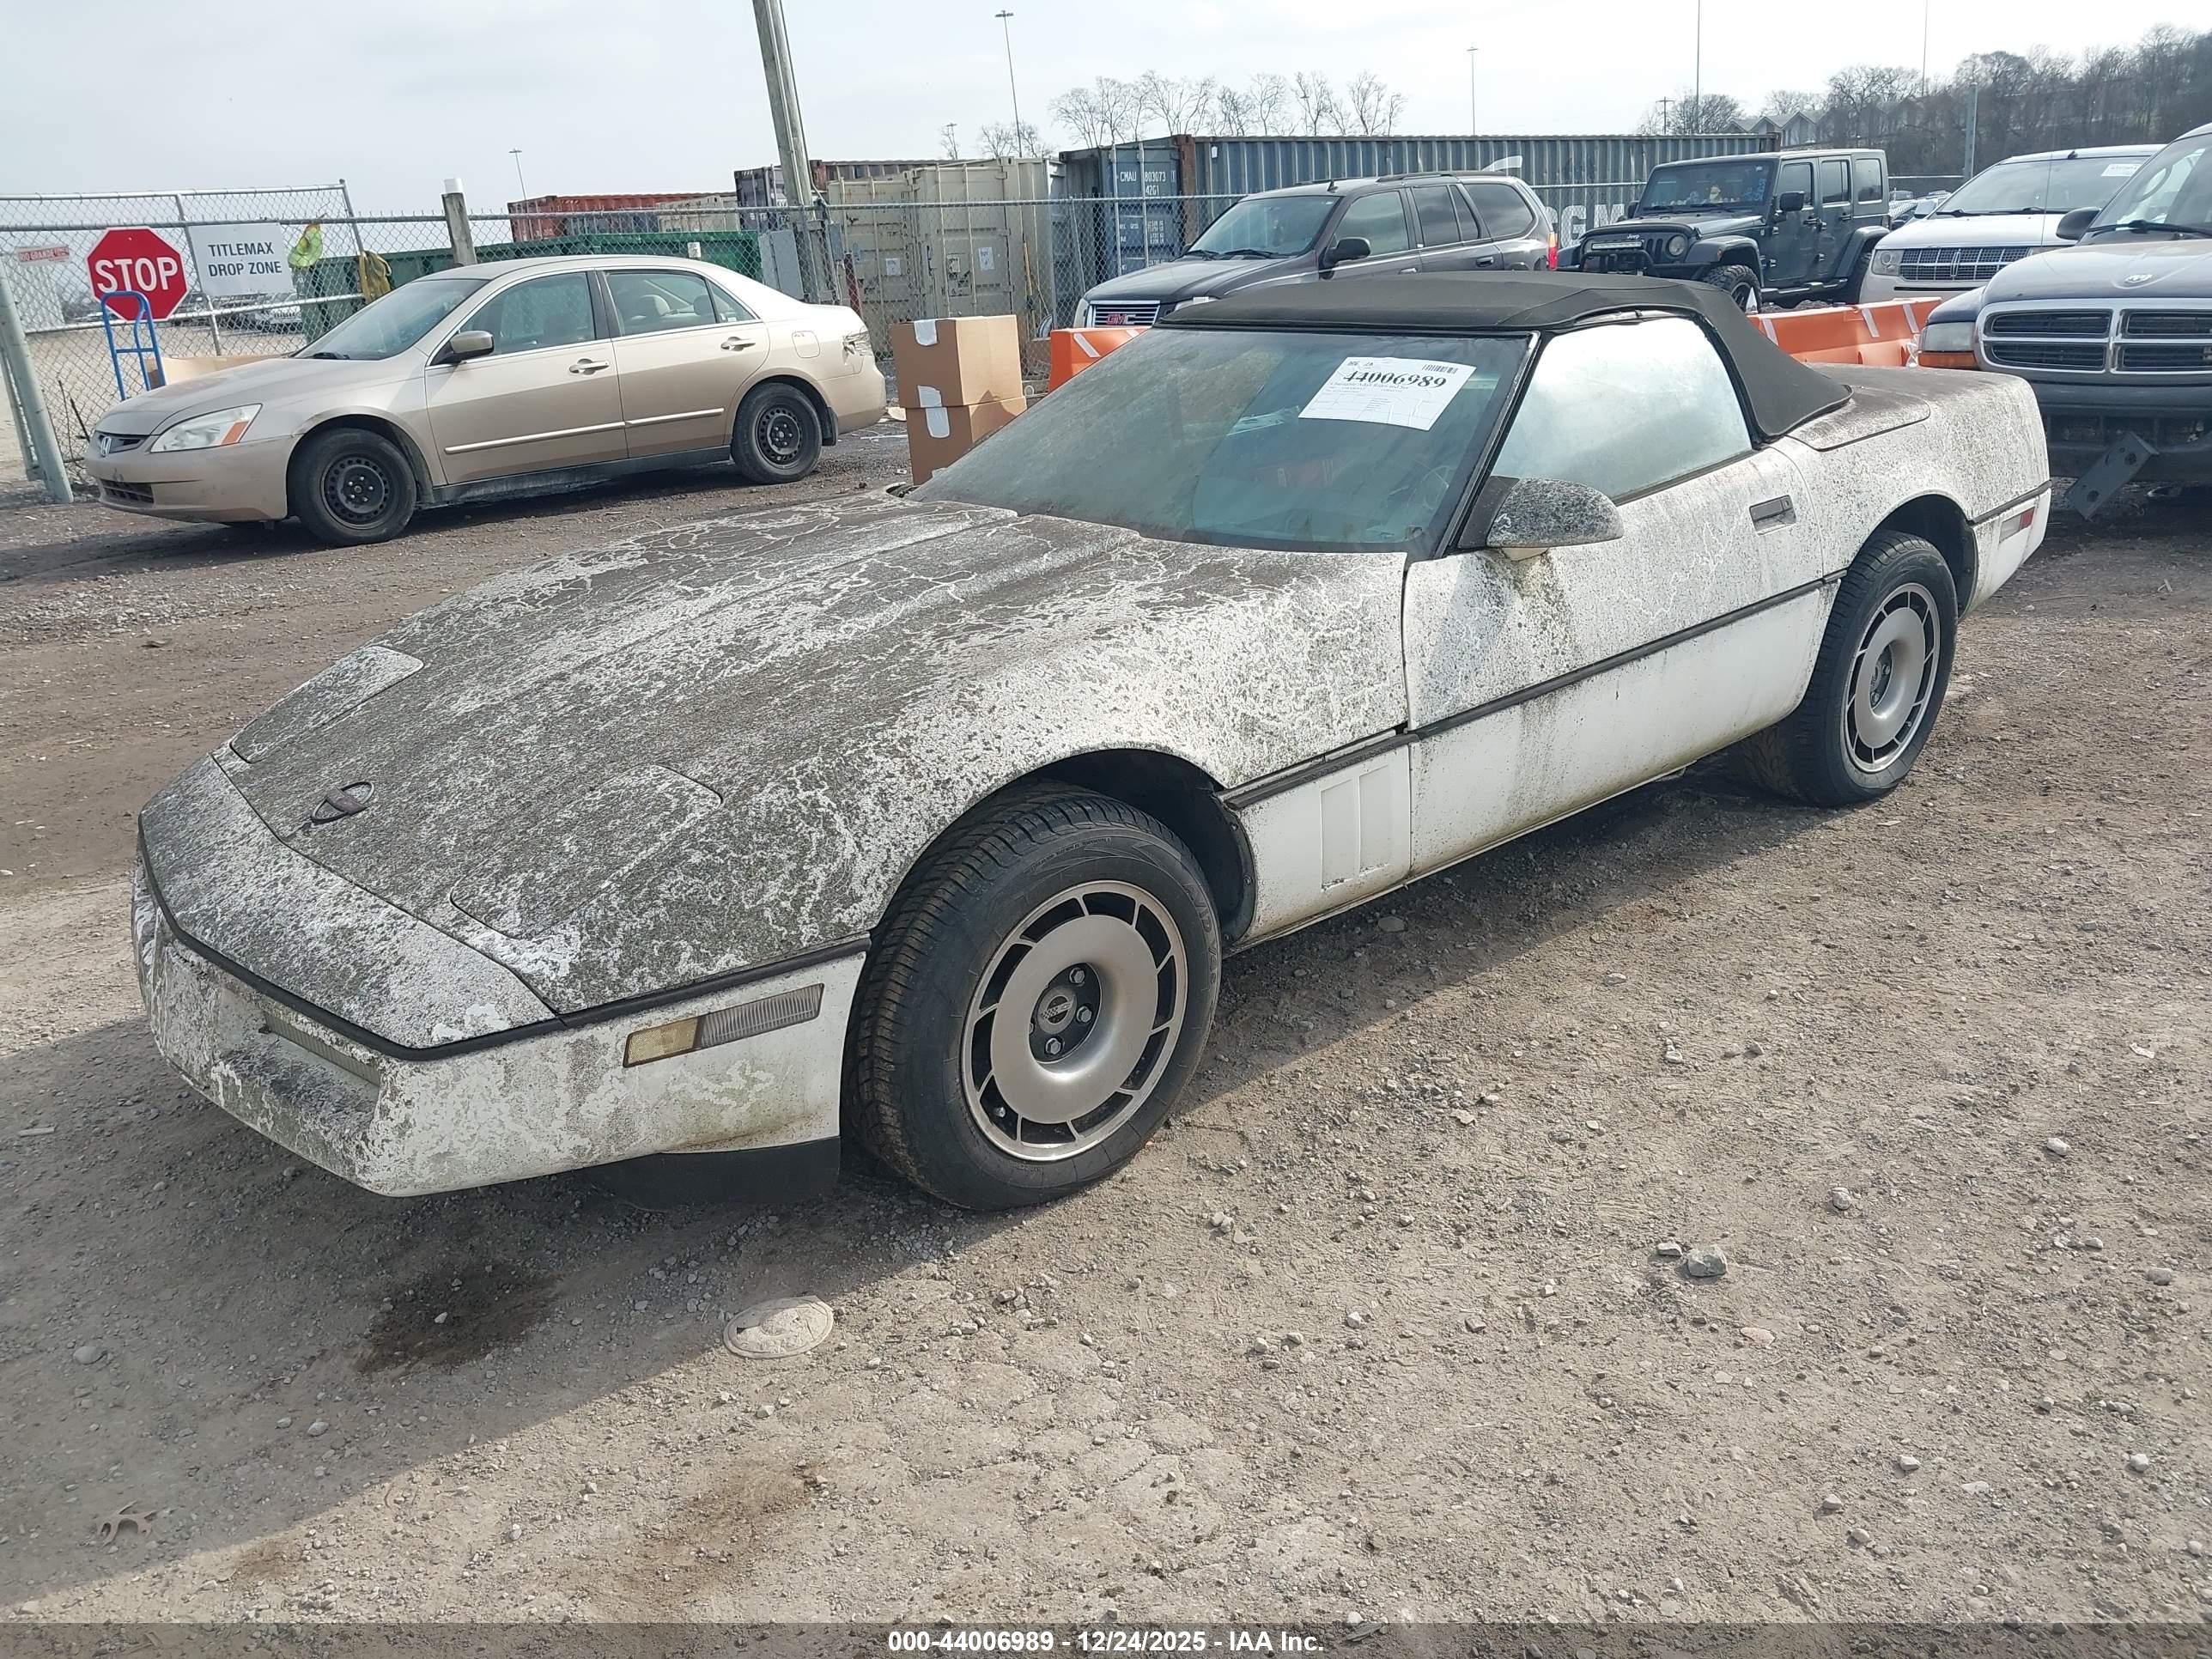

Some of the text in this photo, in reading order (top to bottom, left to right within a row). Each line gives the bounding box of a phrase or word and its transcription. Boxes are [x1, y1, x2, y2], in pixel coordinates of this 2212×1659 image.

[1120, 171, 1137, 182] CMAU
[208, 241, 274, 257] TITLEMAX
[95, 257, 178, 293] STOP
[208, 260, 283, 276] DROP ZONE
[1107, 313, 1136, 325] GMC
[1343, 370, 1447, 388] 44006989
